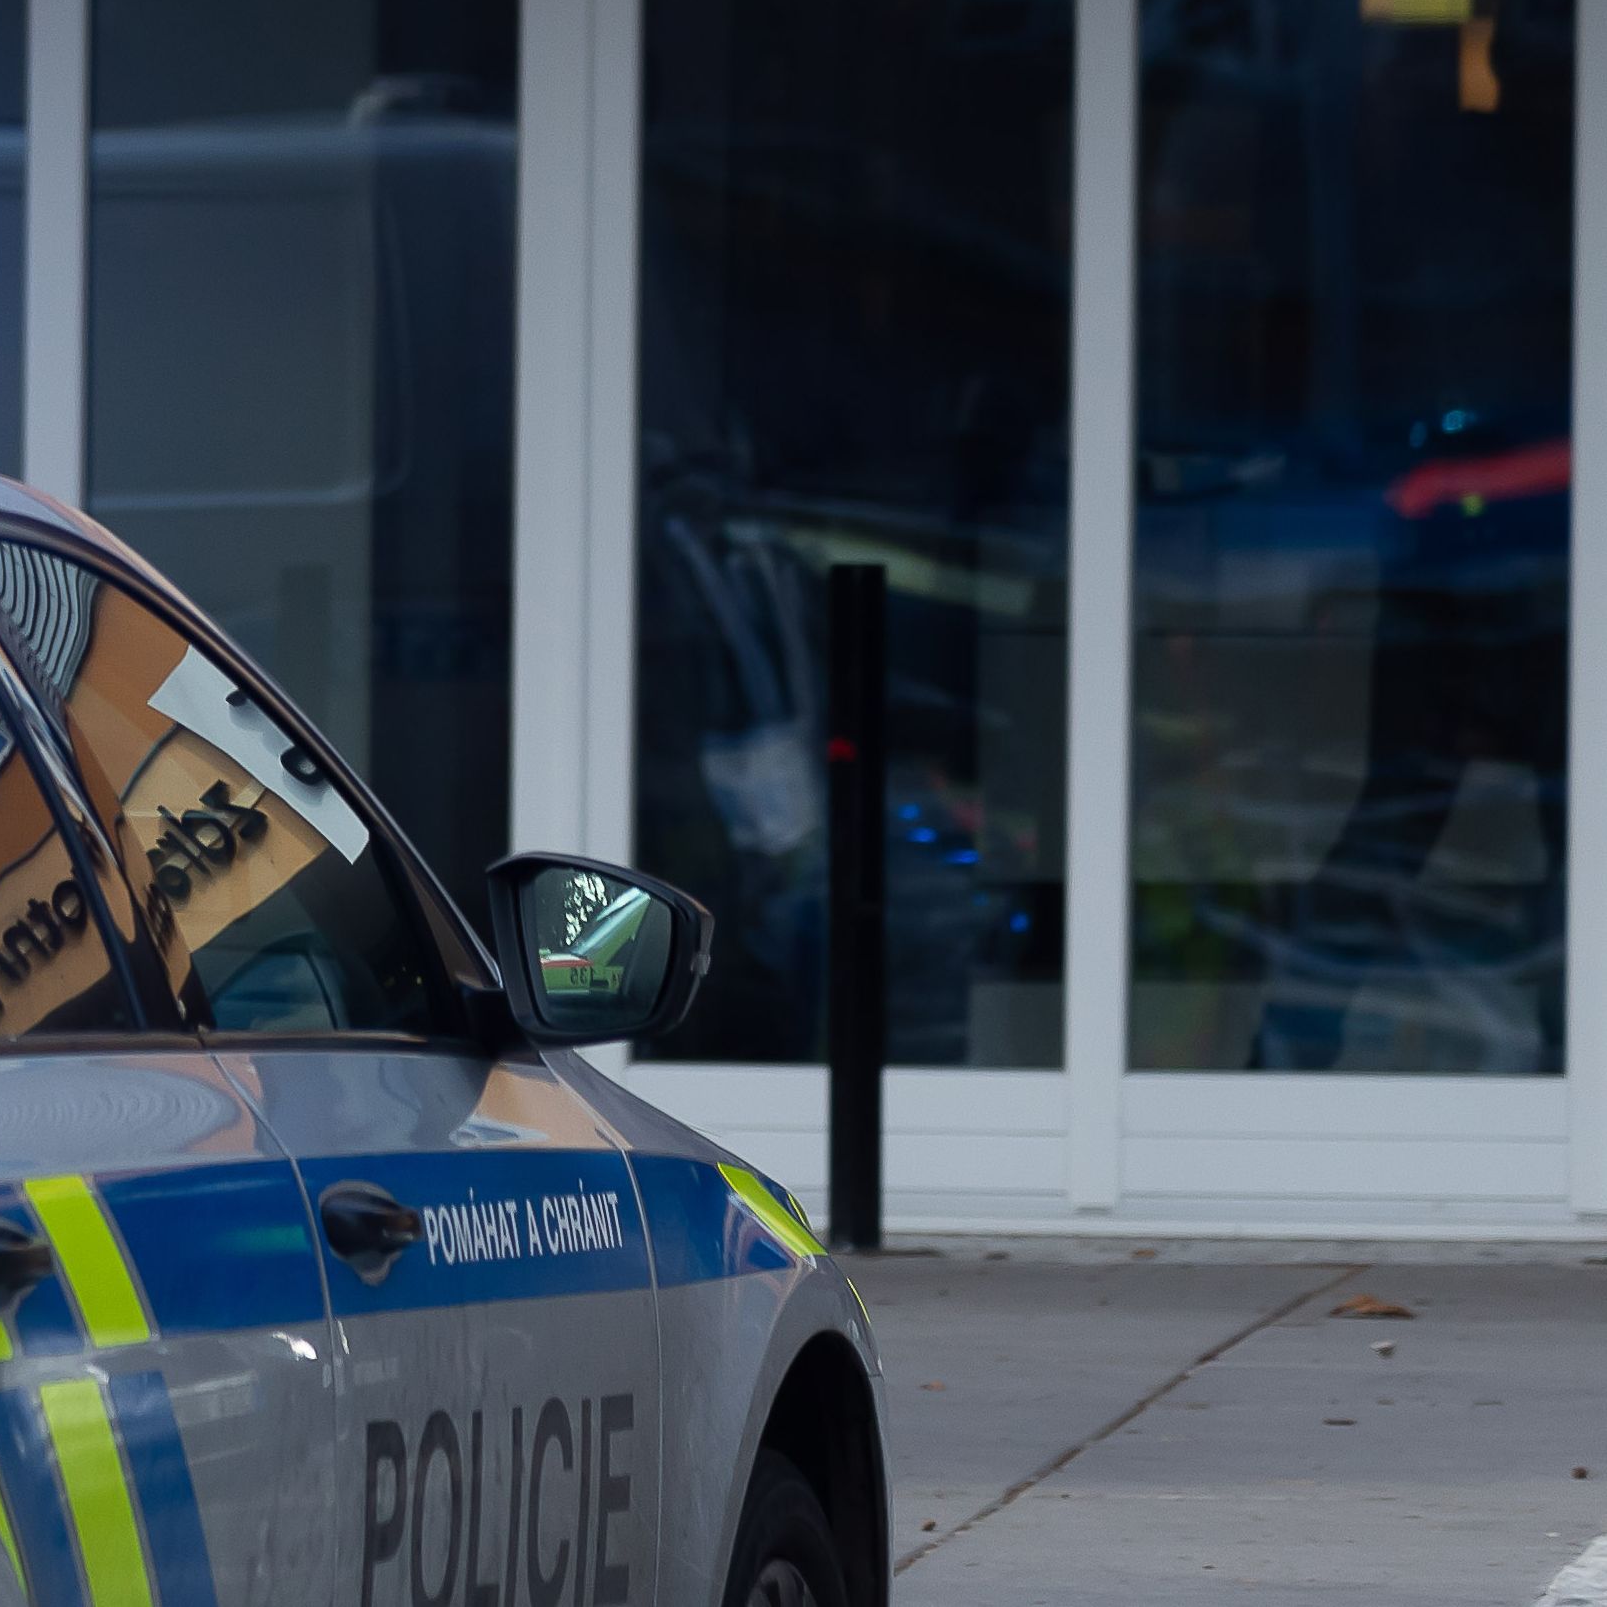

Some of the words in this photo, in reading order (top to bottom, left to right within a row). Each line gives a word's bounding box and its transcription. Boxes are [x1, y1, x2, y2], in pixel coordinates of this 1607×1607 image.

[422, 1186, 521, 1266] POMÁHAT
[525, 1198, 544, 1257] A
[542, 1177, 623, 1255] CHRÁNIT
[360, 1393, 634, 1607] POLICIE
